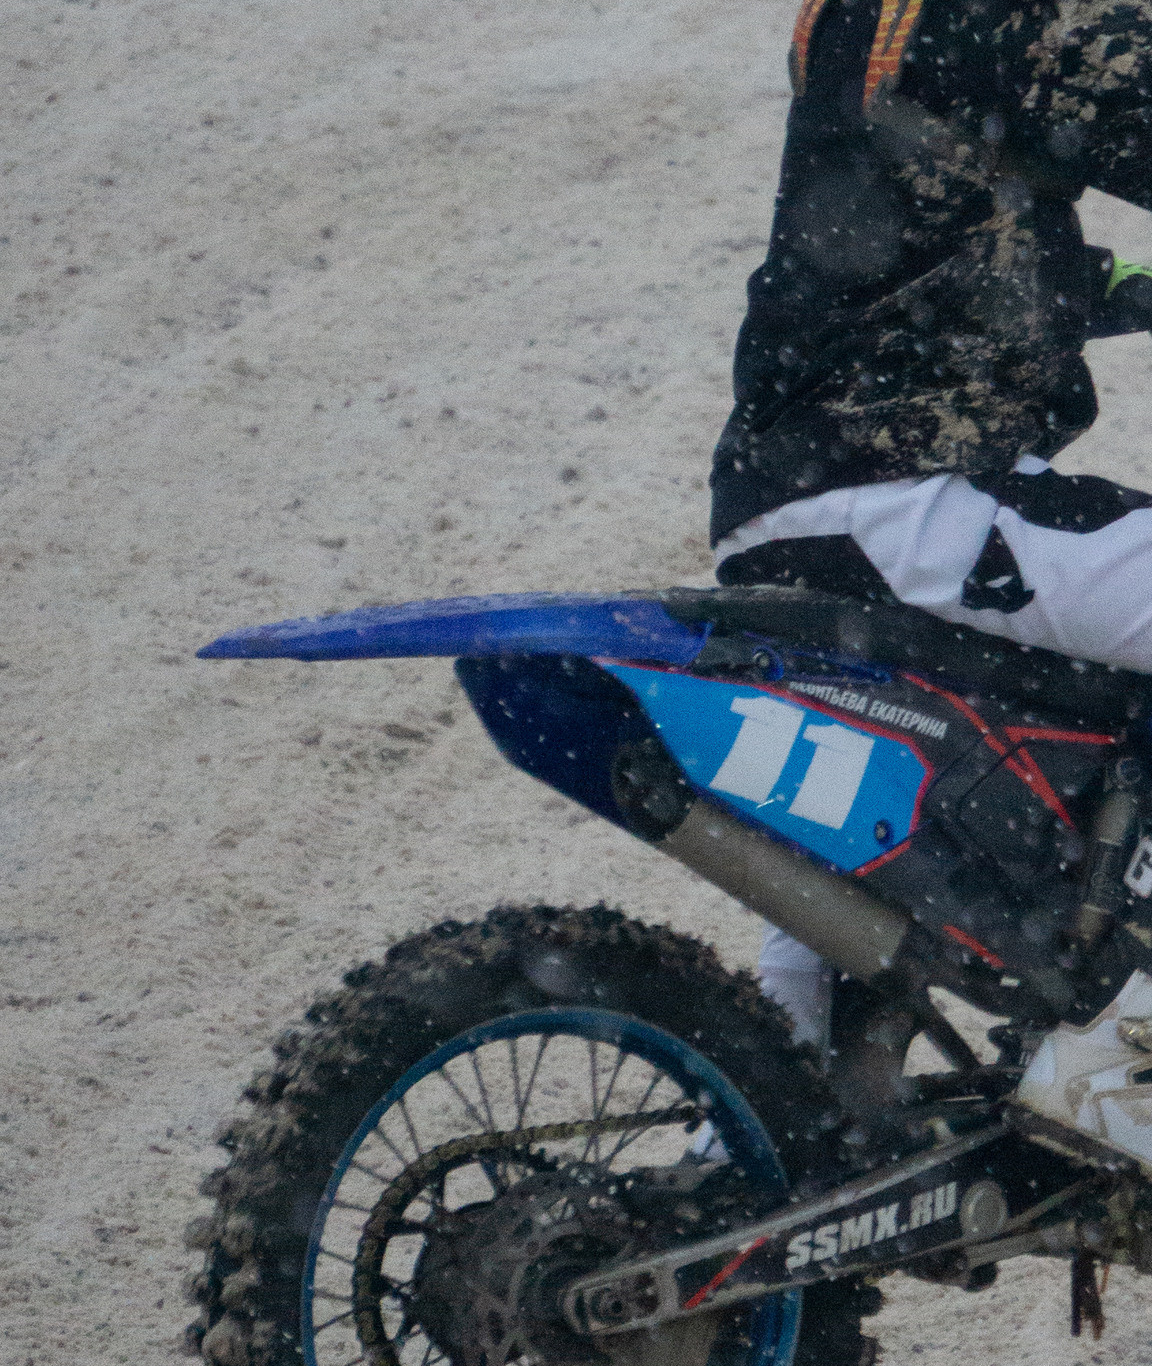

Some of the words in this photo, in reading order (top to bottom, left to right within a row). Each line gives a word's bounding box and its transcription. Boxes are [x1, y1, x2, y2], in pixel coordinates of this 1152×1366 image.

[709, 696, 876, 830] 11
[868, 700, 948, 740] ЕКАТЕРИНА
[785, 1181, 957, 1271] SSMX.RU
